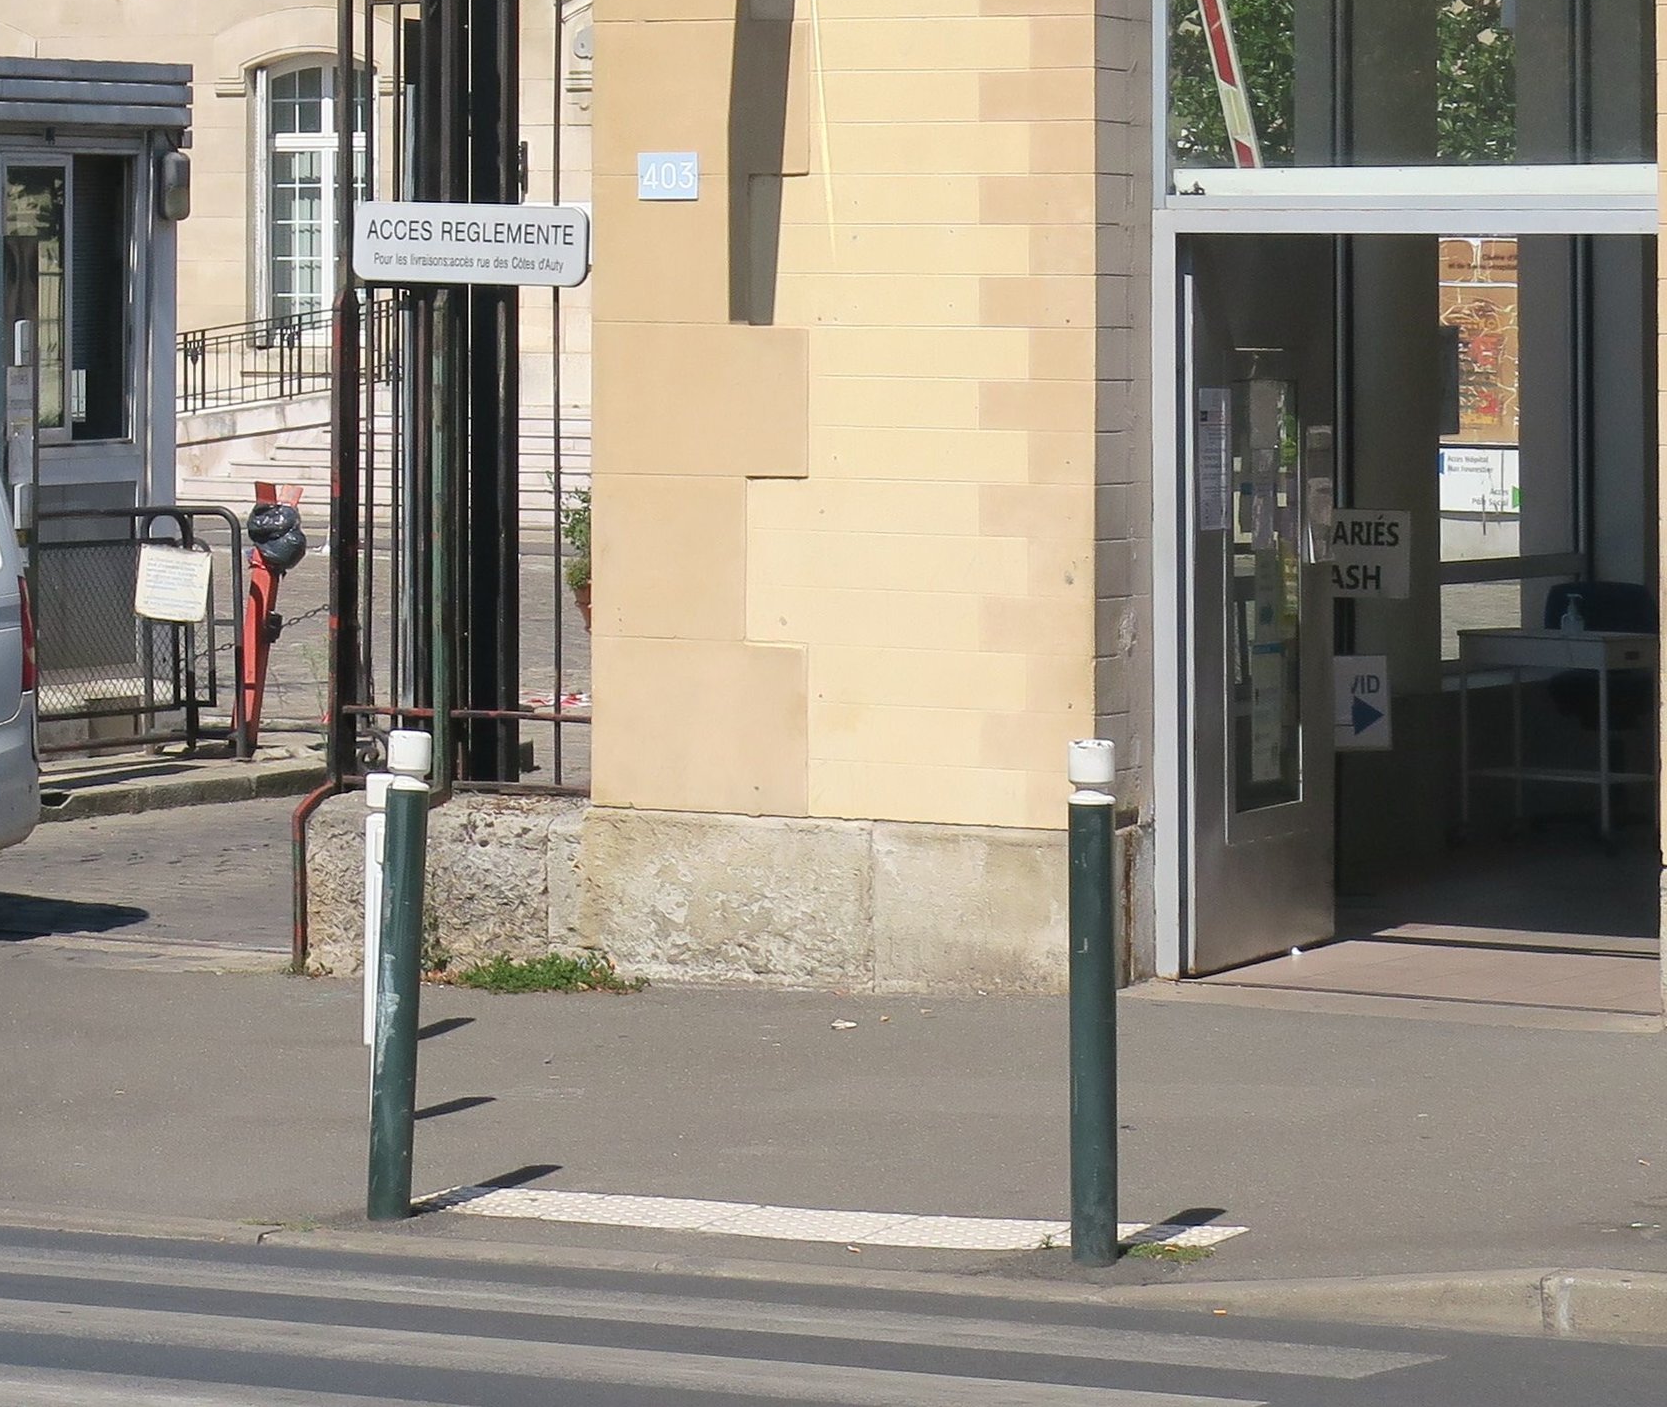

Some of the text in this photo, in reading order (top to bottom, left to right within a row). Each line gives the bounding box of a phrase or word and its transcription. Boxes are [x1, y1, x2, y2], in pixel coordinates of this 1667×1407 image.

[643, 162, 694, 189] 403
[367, 219, 574, 245] ACCES REGLEMENTE
[374, 253, 393, 265] Pour
[395, 253, 407, 265] les
[477, 257, 490, 268] rue
[494, 256, 508, 269] des
[512, 256, 535, 270] Côtes
